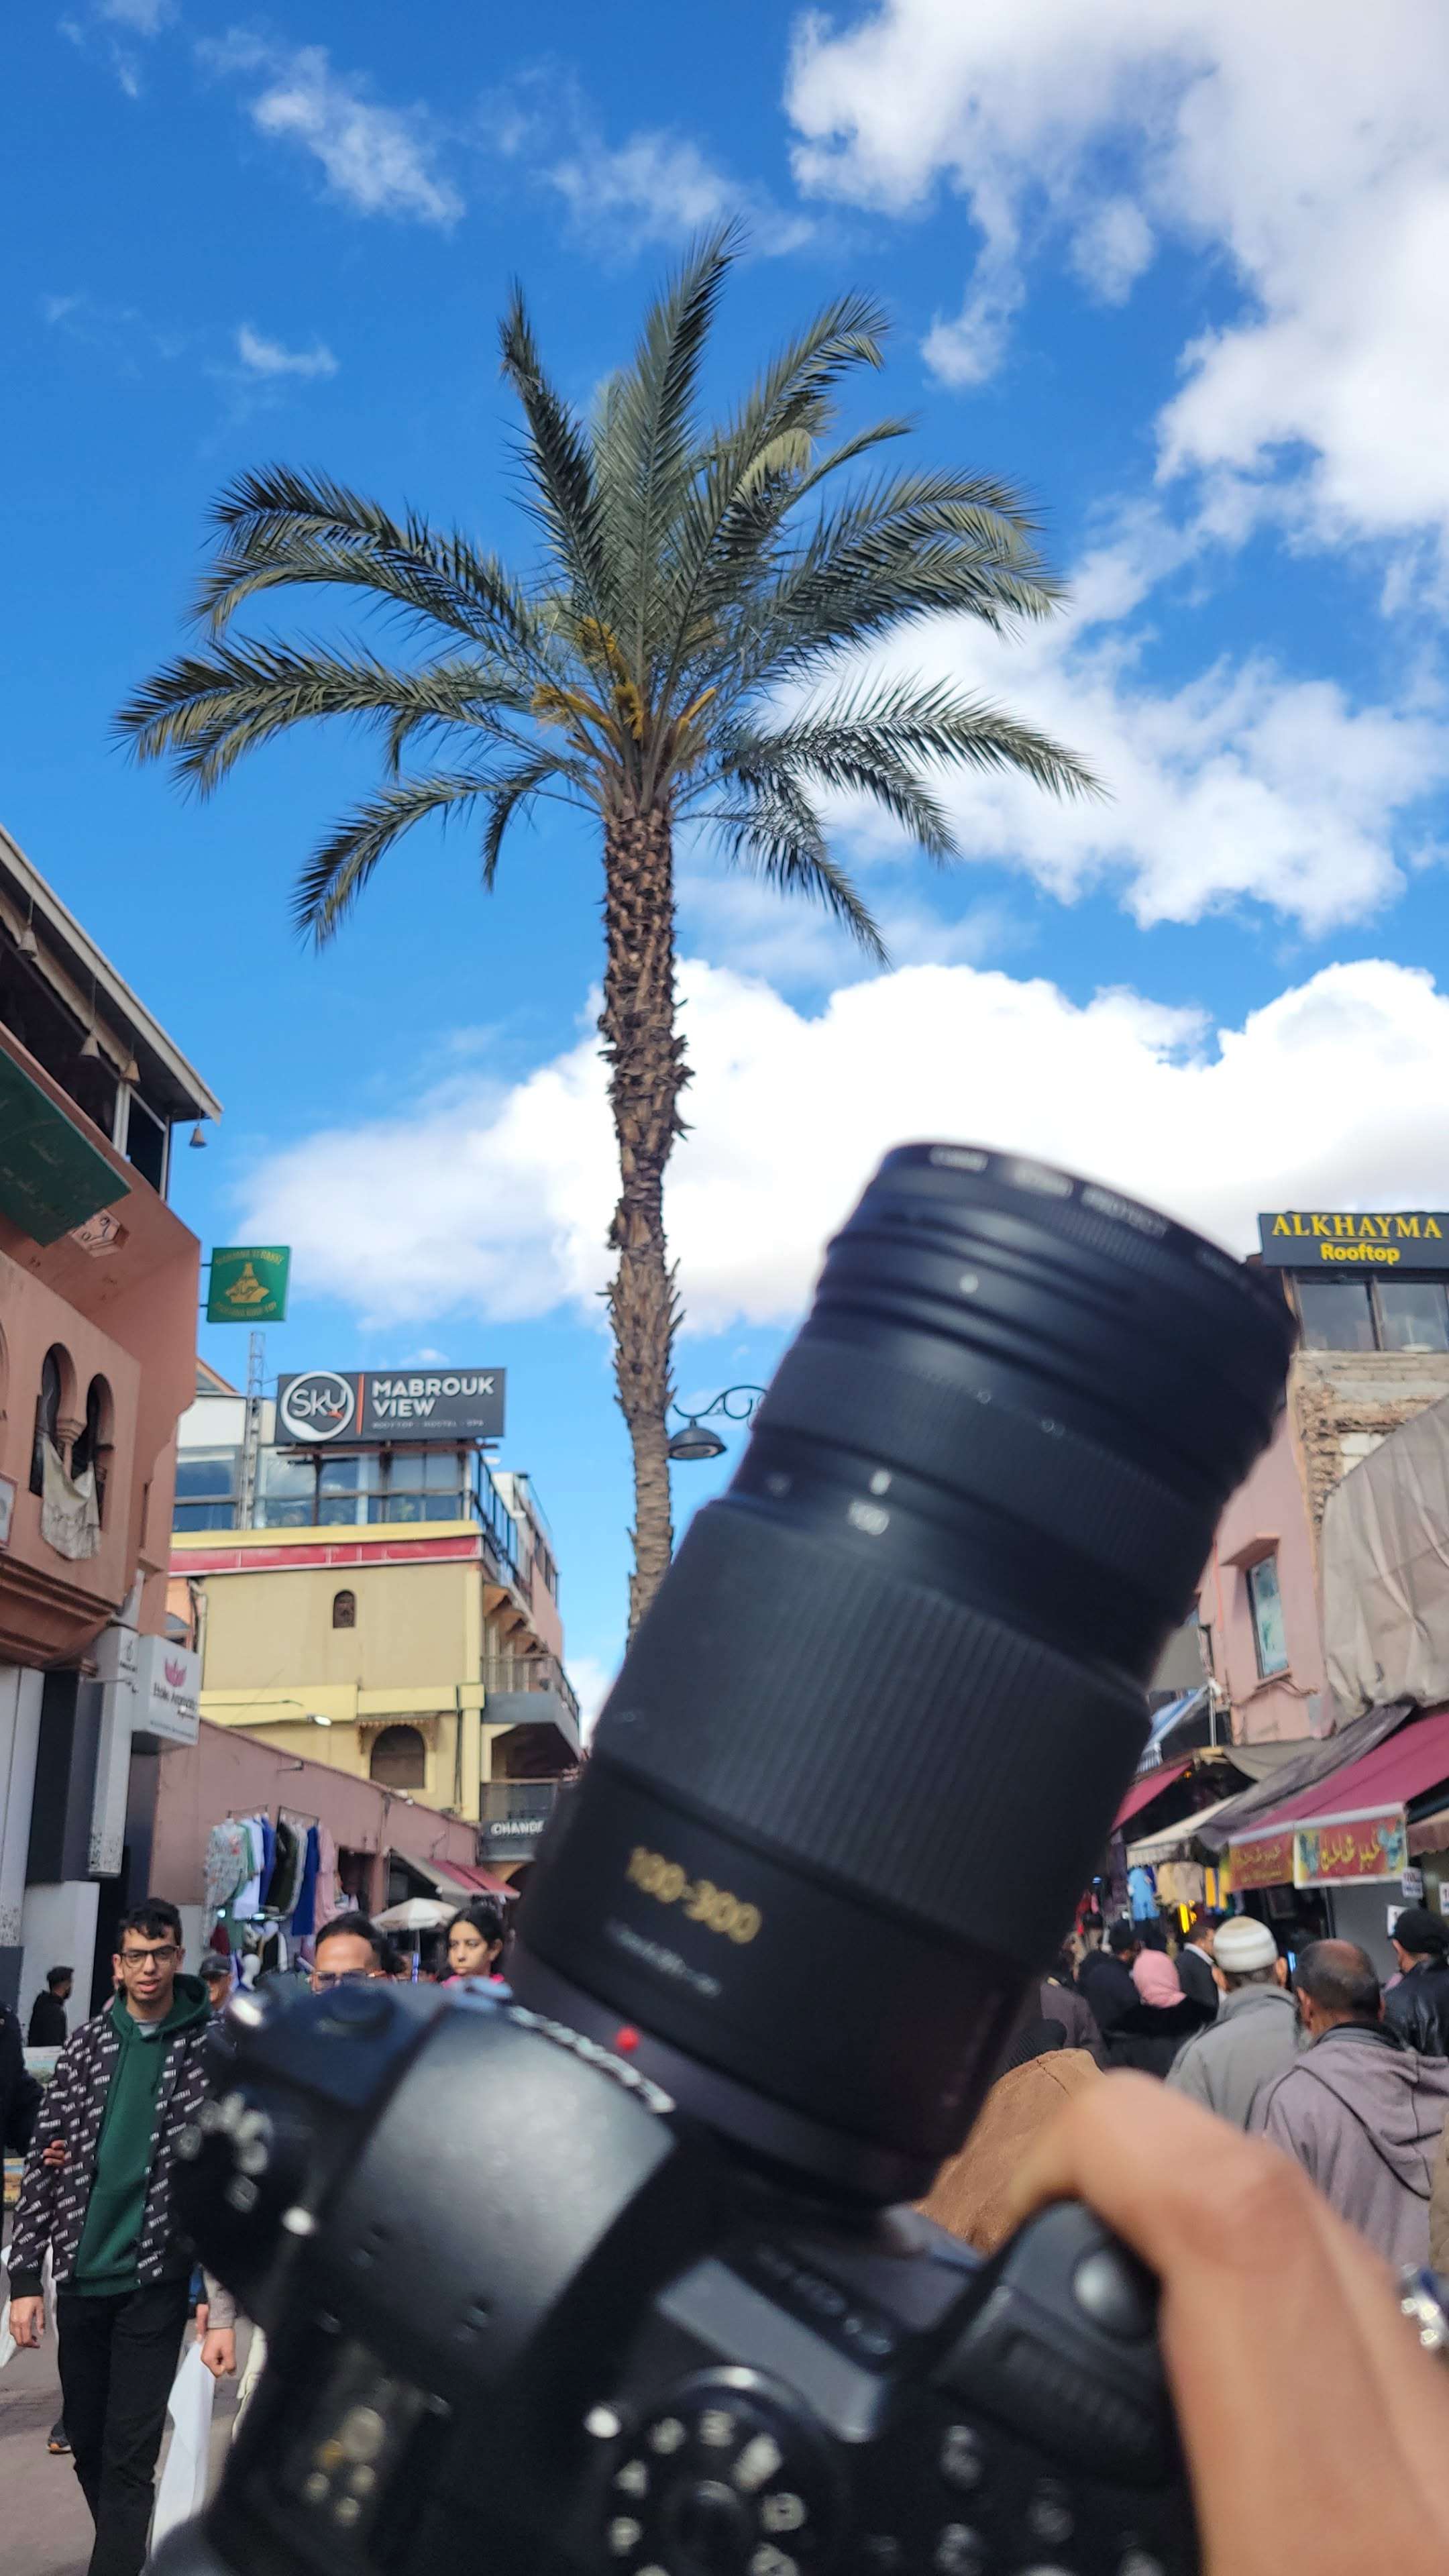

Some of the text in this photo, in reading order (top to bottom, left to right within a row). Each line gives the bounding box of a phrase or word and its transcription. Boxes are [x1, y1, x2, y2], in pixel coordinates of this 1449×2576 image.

[1272, 1214, 1443, 1239] ALKHAYMA
[1320, 1242, 1401, 1266] Rooftop
[371, 1375, 495, 1399] MABROUK
[372, 1398, 436, 1419] VIEW
